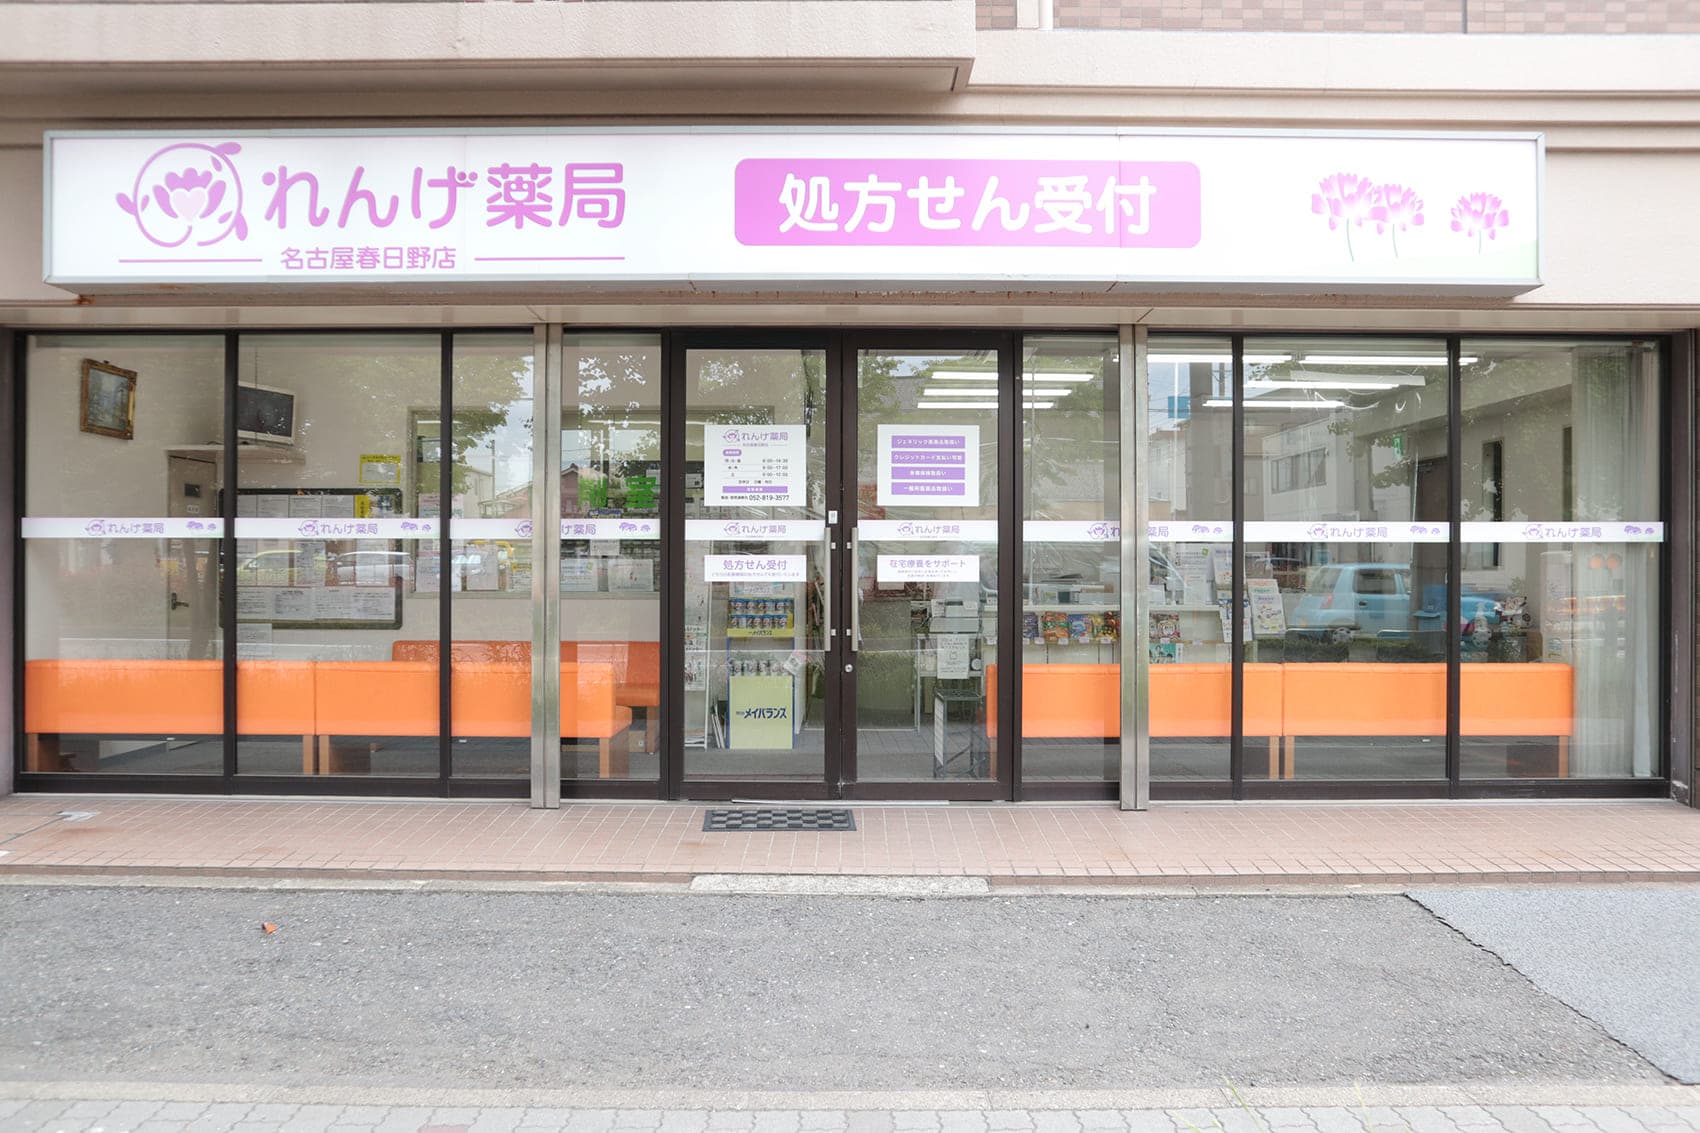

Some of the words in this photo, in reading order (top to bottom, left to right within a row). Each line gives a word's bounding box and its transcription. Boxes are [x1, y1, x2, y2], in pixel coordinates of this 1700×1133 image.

[262, 162, 626, 229] れんげ薬局
[779, 172, 1157, 235] 処方せん受付
[280, 246, 457, 270] 名古屋春日野店
[108, 523, 165, 534] れんげ薬局
[320, 523, 378, 535] れんげ薬局
[1330, 527, 1388, 538] れんげ薬局
[1544, 526, 1602, 538] れんげ薬局
[723, 559, 787, 570] 処方せん受付
